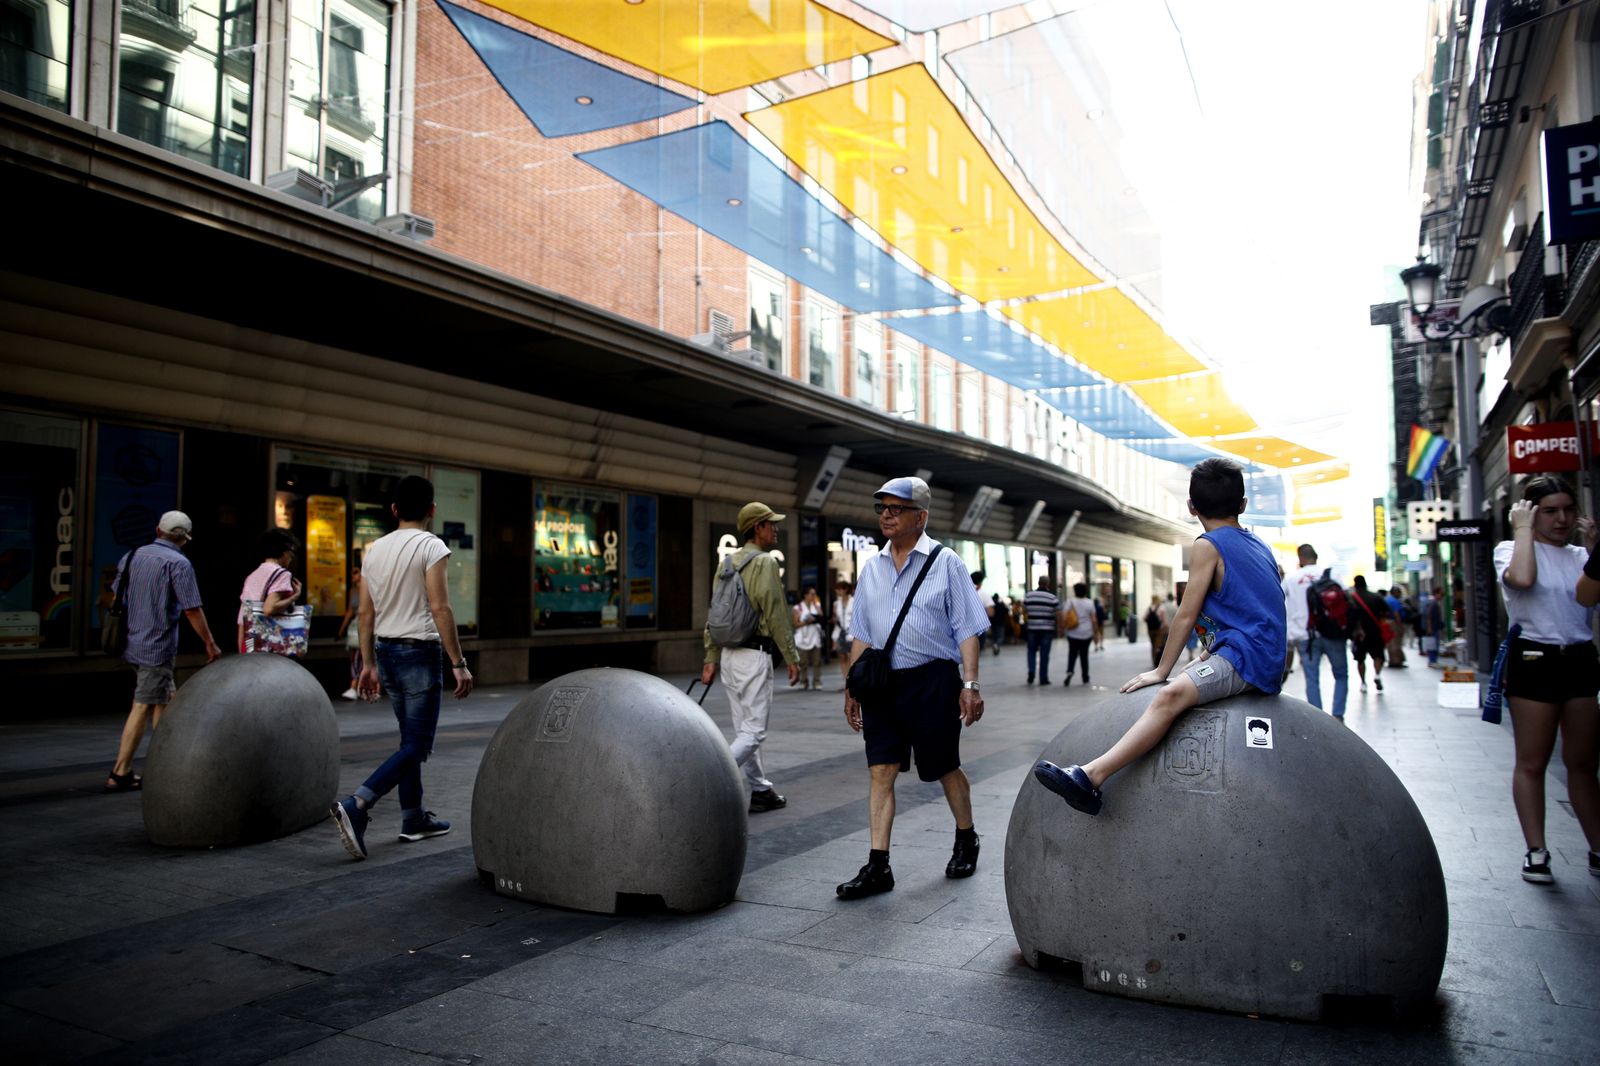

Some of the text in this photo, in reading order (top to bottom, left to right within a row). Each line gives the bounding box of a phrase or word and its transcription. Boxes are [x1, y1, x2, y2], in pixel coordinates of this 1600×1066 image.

[1567, 143, 1600, 175] P
[1514, 437, 1579, 459] CAMPER
[50, 486, 74, 593] fnac
[842, 527, 875, 551] fnac
[1439, 526, 1480, 536] GEOX
[1100, 969, 1148, 990] 068
